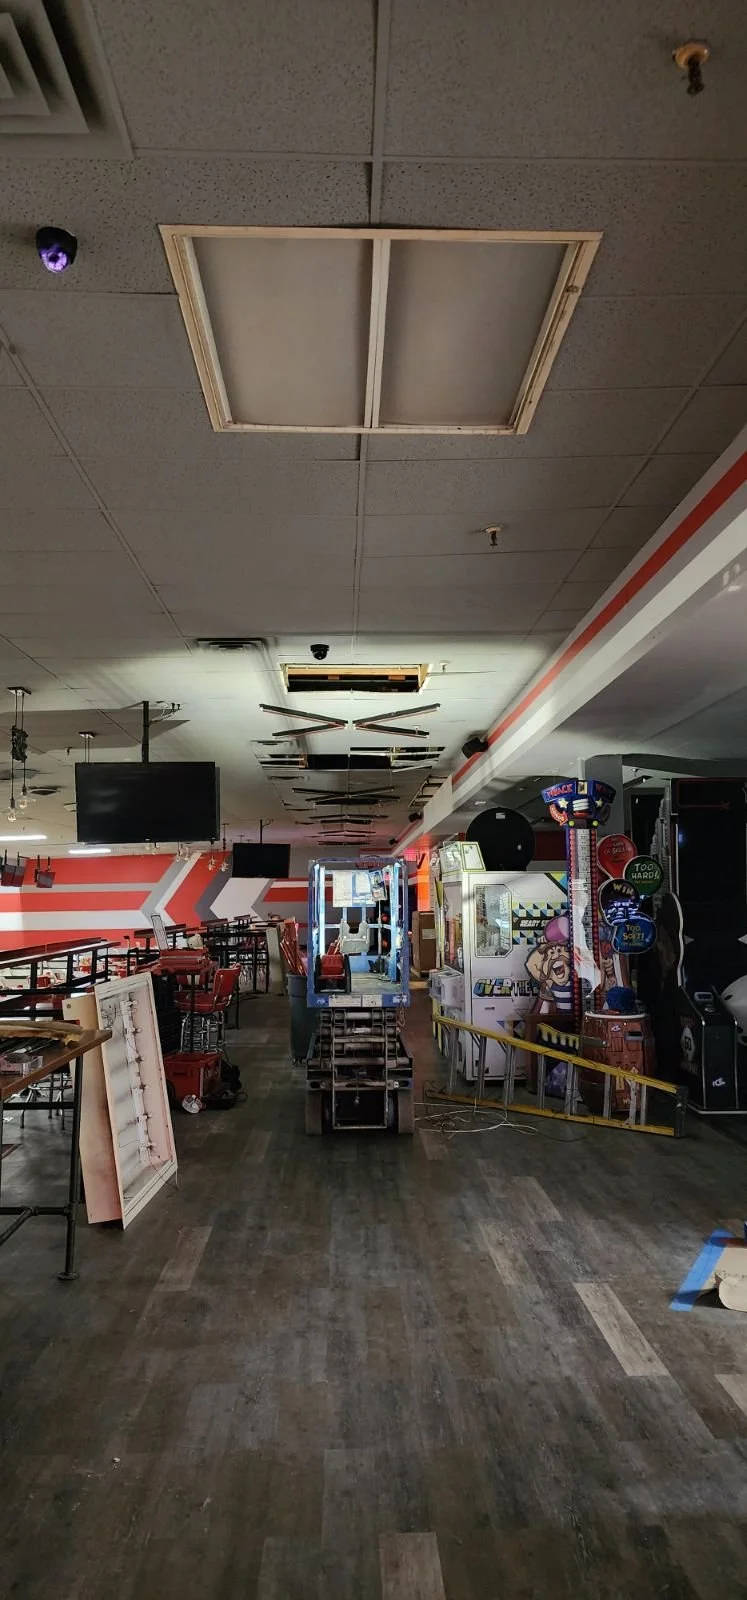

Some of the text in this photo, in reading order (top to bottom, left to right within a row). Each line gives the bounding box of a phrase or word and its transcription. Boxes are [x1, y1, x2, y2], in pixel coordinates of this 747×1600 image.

[634, 863, 655, 872] TOO
[631, 870, 659, 880] HARD!
[612, 883, 634, 896] WIN
[519, 920, 541, 928] READY
[625, 924, 641, 932] TOO
[473, 977, 512, 997] OVER
